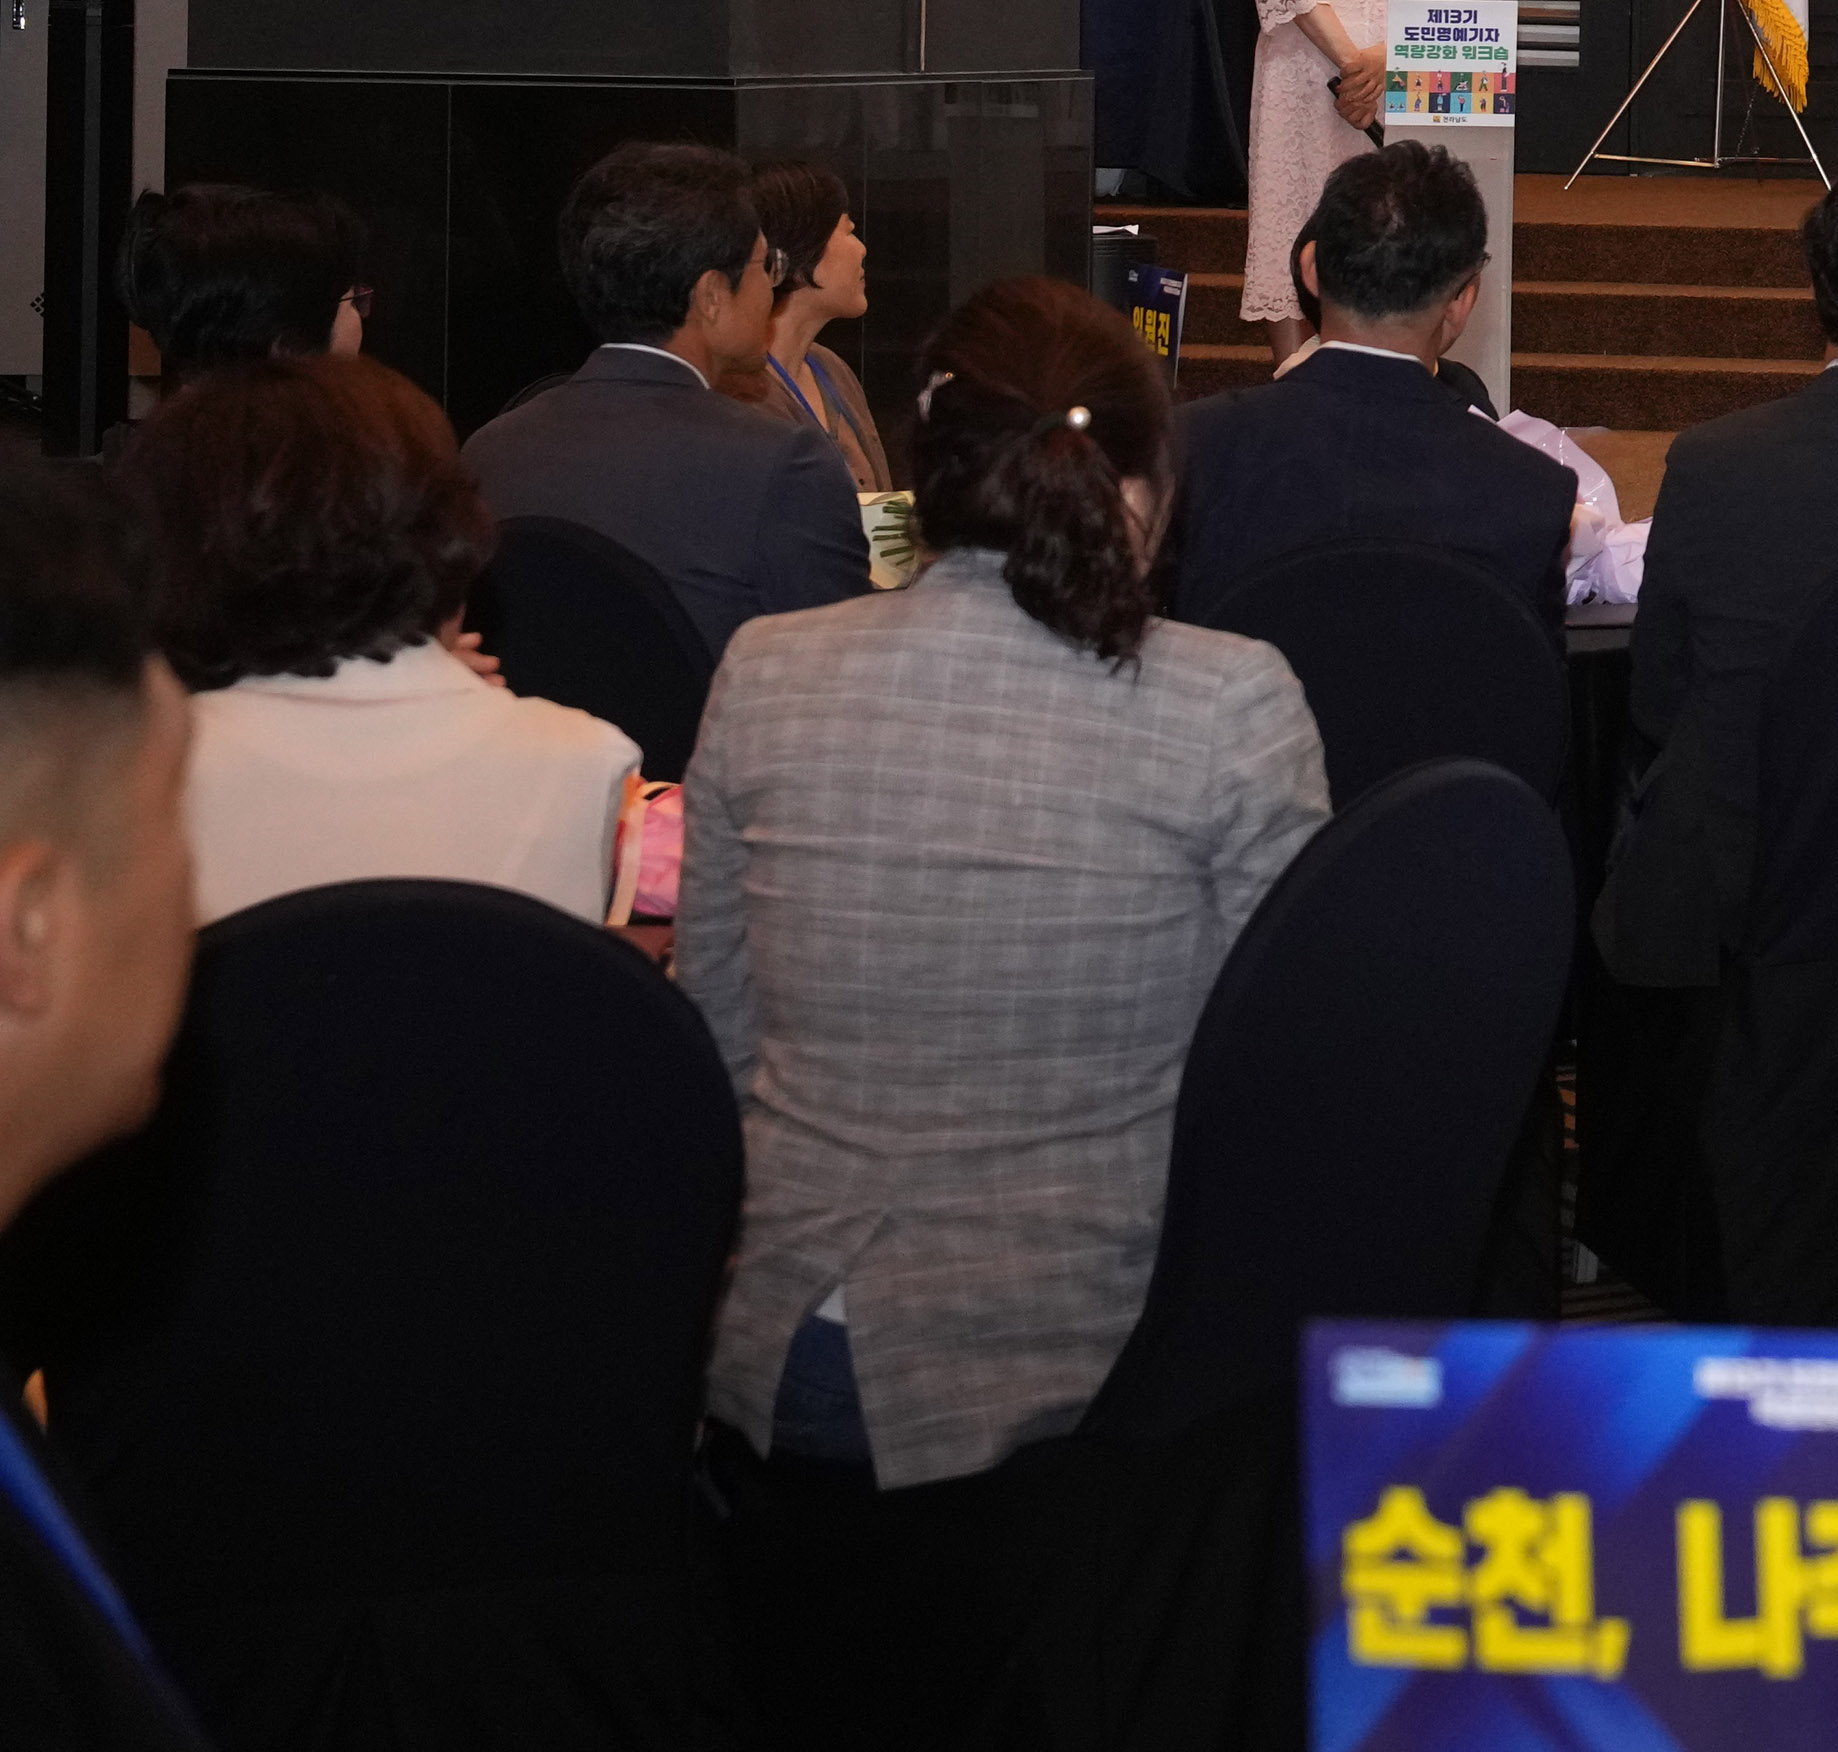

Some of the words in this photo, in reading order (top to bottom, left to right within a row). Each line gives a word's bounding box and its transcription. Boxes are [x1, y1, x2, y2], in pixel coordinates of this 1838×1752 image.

[1427, 9, 1478, 24] 제13기
[1405, 27, 1499, 42] 도민명예기자
[1395, 45, 1457, 59] 역량강화
[1462, 46, 1508, 60] 워크숍
[1343, 1486, 1629, 1678] 순천,
